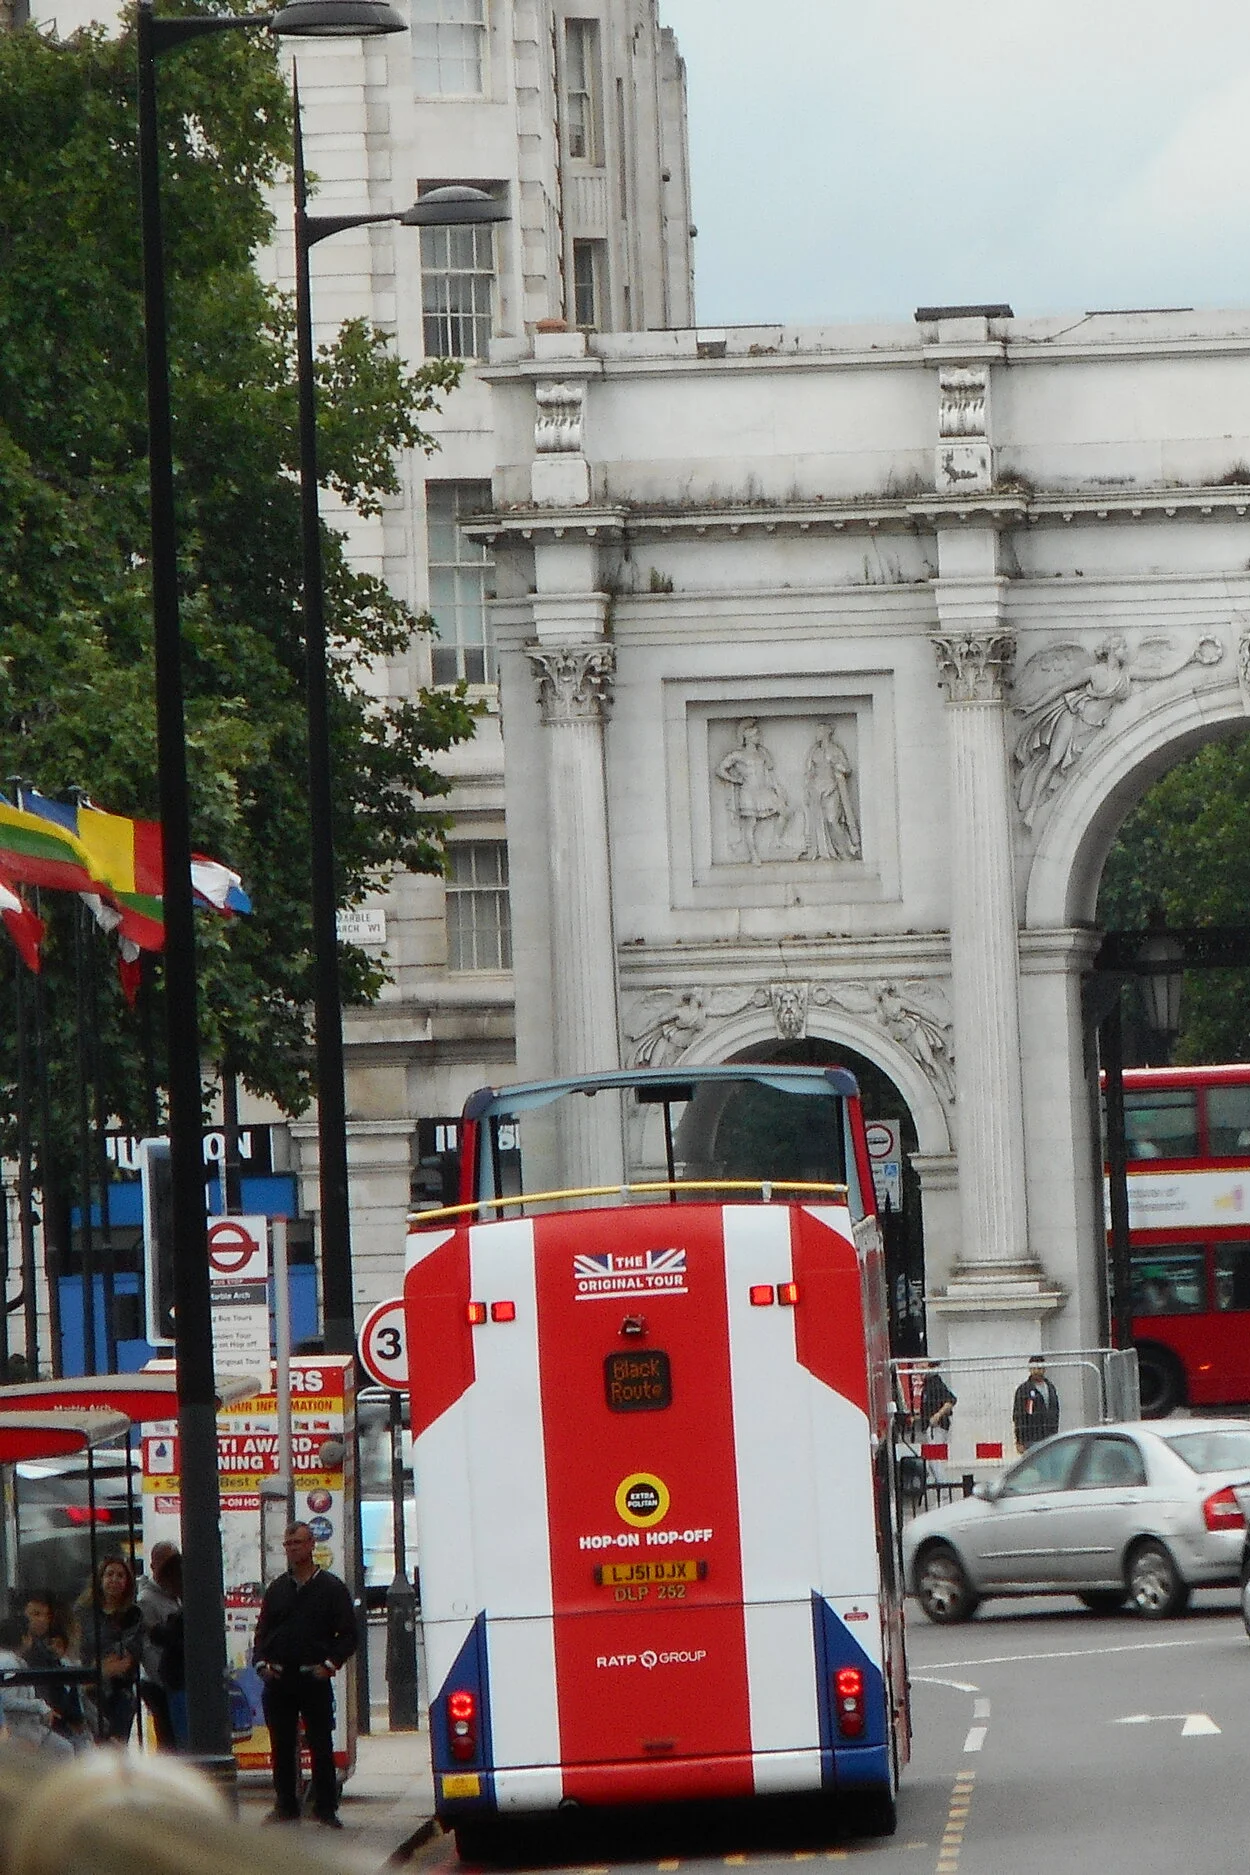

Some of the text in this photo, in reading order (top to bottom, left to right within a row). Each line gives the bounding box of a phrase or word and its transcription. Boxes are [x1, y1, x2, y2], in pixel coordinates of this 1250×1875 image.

[615, 1255, 643, 1268] THE
[578, 1274, 683, 1292] ORIGINAL TOUR
[613, 1359, 660, 1380] Black
[611, 1381, 662, 1403] Route
[256, 1400, 332, 1412] INFMATION
[221, 1477, 249, 1488] Best
[630, 1492, 654, 1500] EXTRA
[579, 1528, 713, 1549] HOP-ON HOP-OFF
[612, 1561, 686, 1582] LJ51 DJX
[615, 1586, 649, 1601] DLP
[596, 1650, 707, 1668] RATP GROUP
